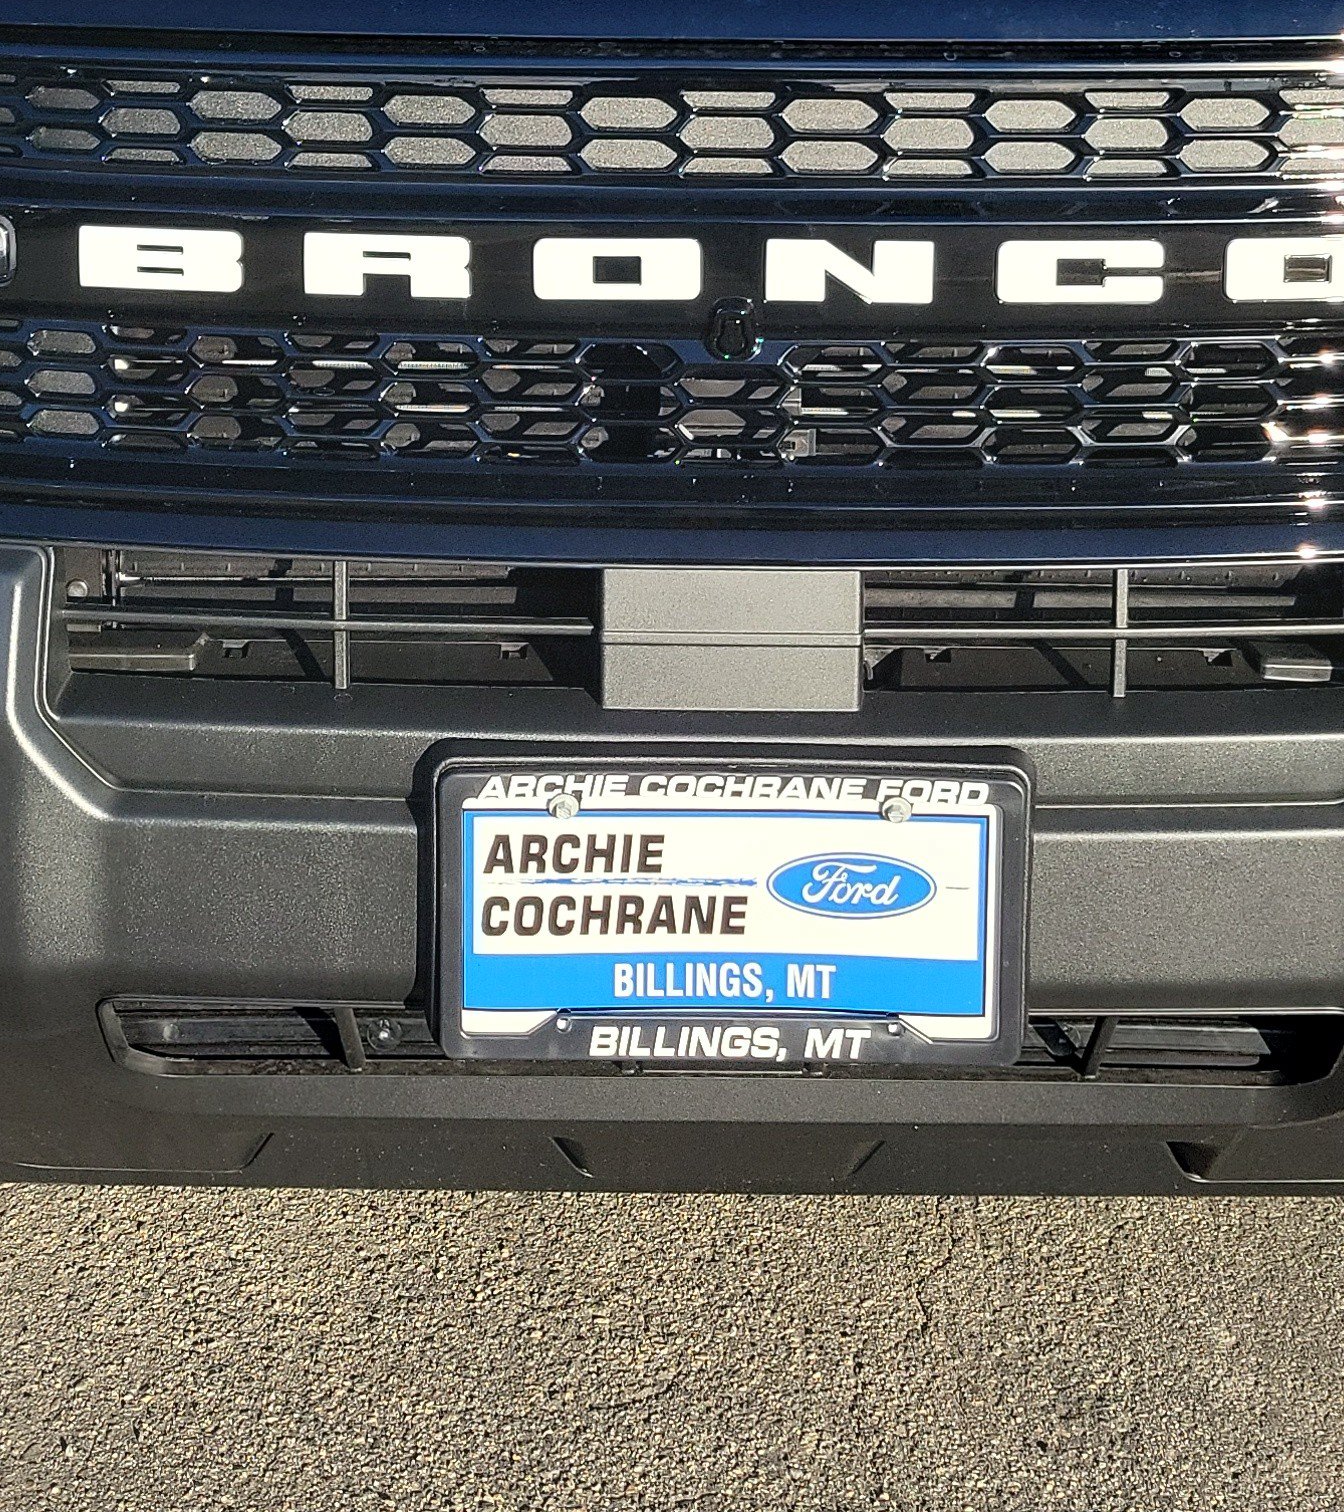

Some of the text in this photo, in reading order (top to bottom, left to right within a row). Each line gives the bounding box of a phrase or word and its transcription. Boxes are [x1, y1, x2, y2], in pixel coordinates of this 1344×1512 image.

[477, 773, 990, 805] ARCHIE COCHRANE FORD
[483, 834, 665, 874] ARCHIE
[802, 861, 902, 906] Ford
[481, 895, 748, 936] COCHRANE
[614, 962, 837, 1003] BILLINGS, MT
[589, 1025, 872, 1062] BILLINGS, MT
